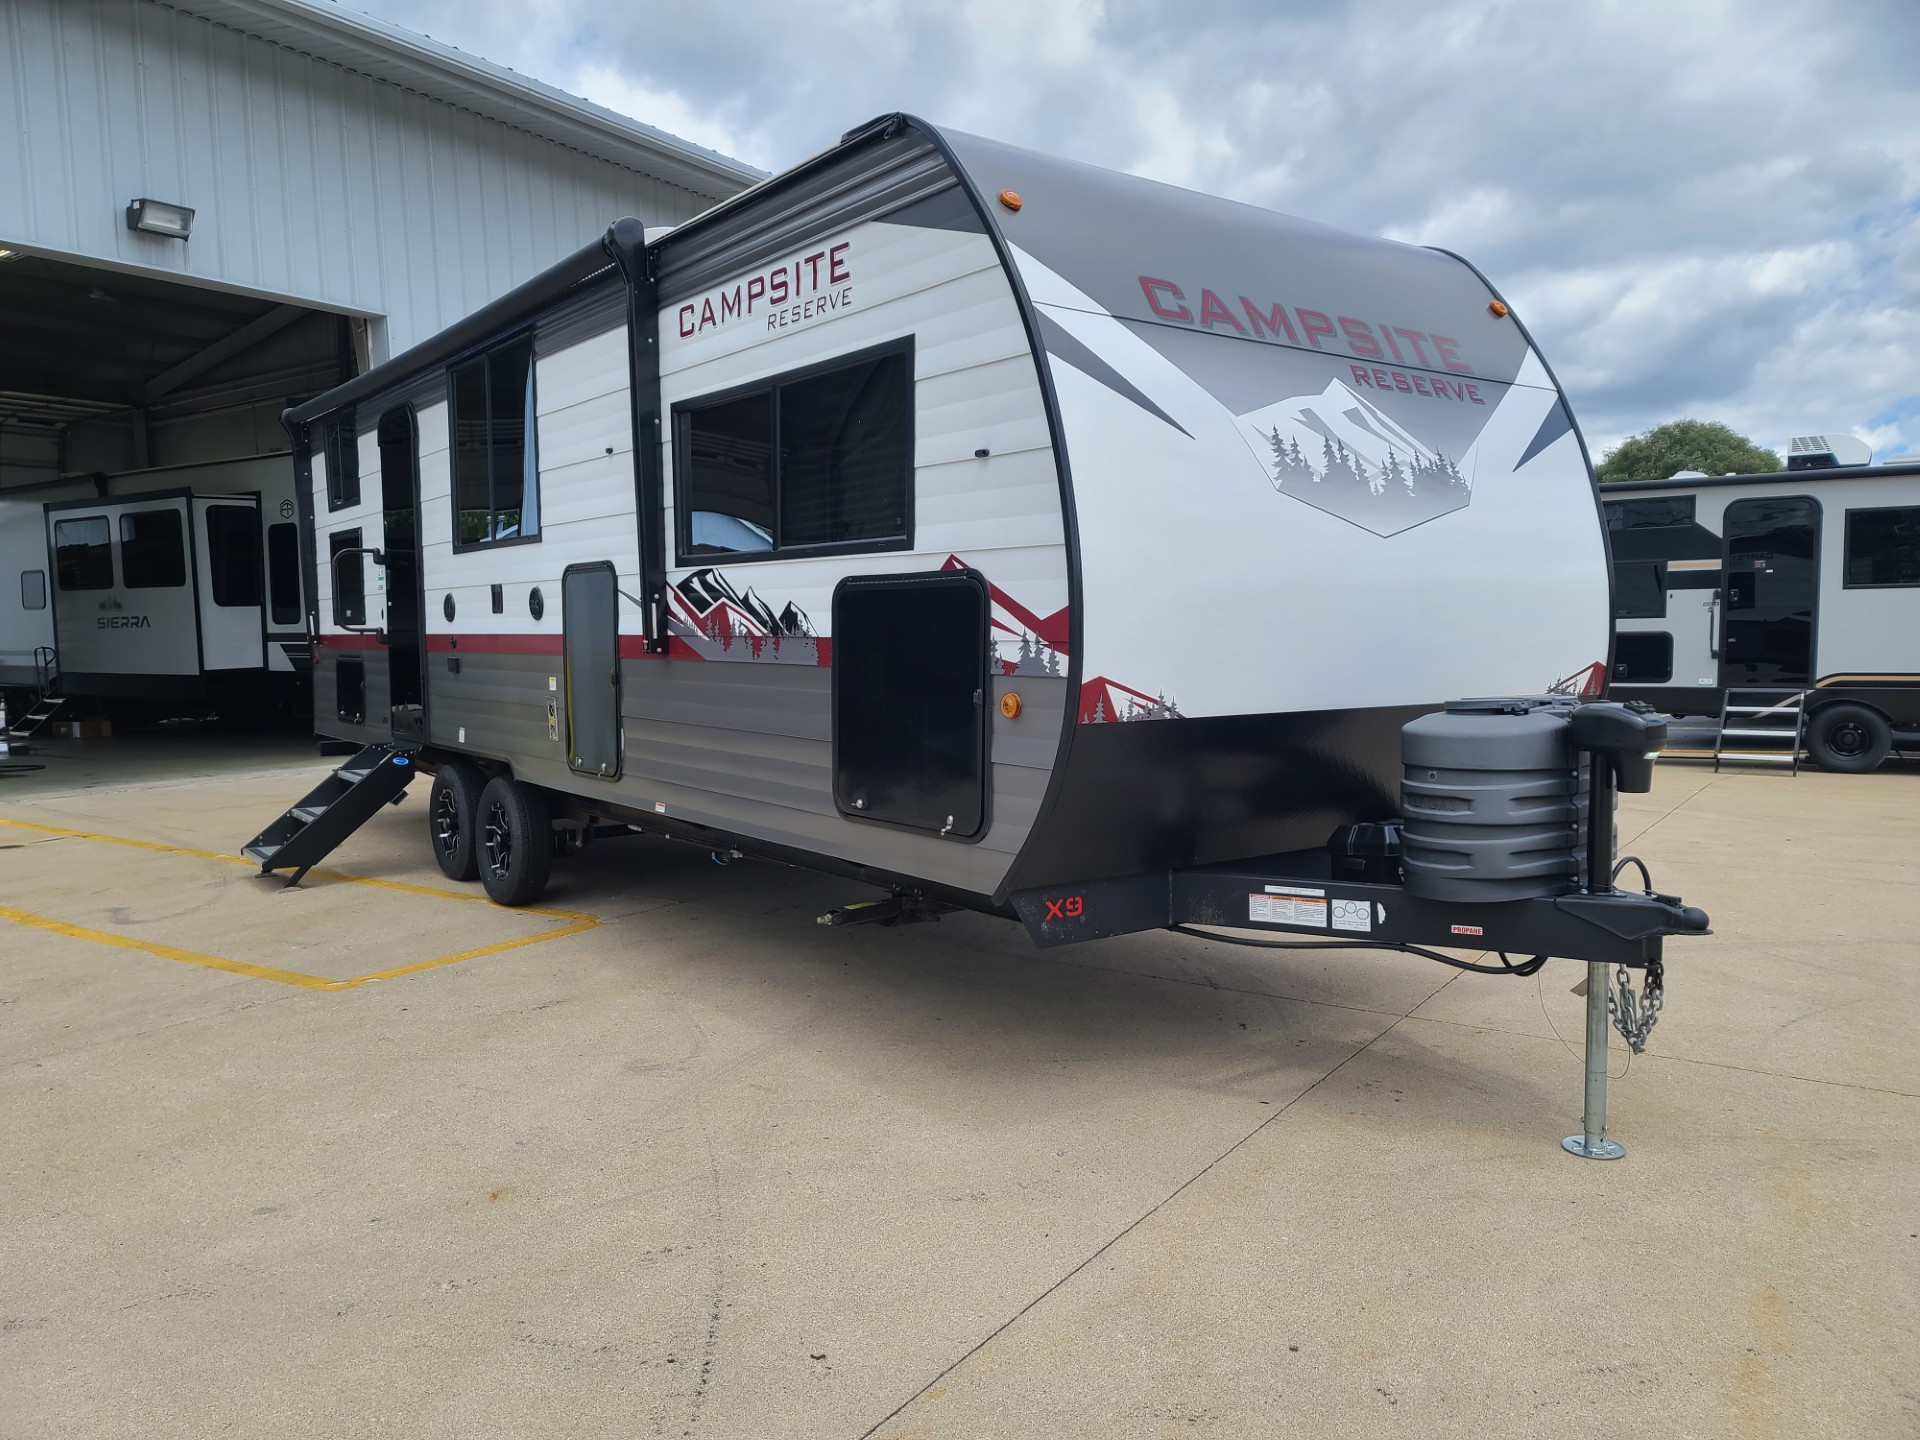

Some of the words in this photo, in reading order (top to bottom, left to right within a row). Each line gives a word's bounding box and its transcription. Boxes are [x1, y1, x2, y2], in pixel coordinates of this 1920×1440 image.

[679, 241, 850, 339] CAMPSITE
[767, 286, 852, 331] RESERVE
[1138, 275, 1474, 373] CAMPSITE
[1350, 364, 1485, 404] RESERVE
[97, 615, 151, 629] SIERRA
[1044, 896, 1083, 921] X9
[1452, 926, 1482, 935] PROPANE
